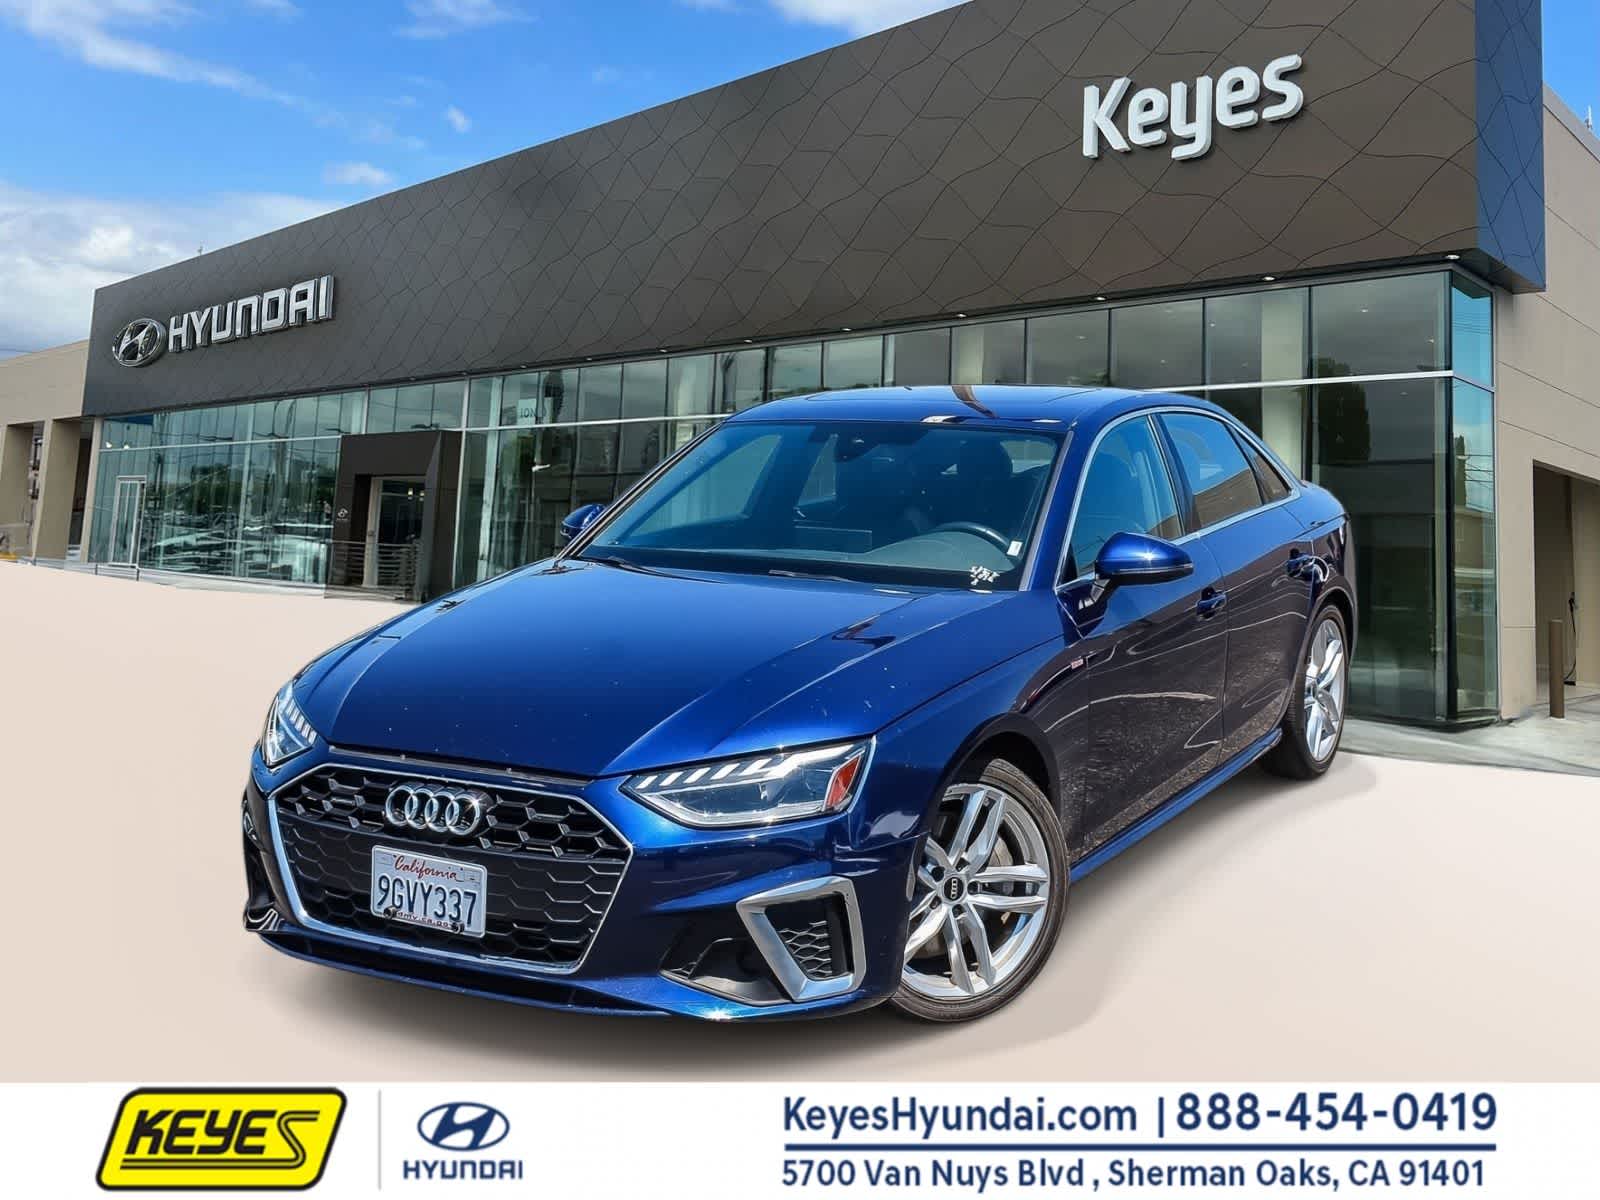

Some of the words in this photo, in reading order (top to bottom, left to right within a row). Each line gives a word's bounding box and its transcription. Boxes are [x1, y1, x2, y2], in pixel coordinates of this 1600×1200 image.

[1082, 54, 1304, 161] Keyes
[168, 275, 335, 353] HYUNDAI
[393, 853, 461, 882] California
[377, 874, 477, 927] 9GVY337
[397, 911, 454, 929] dmv.ca.go
